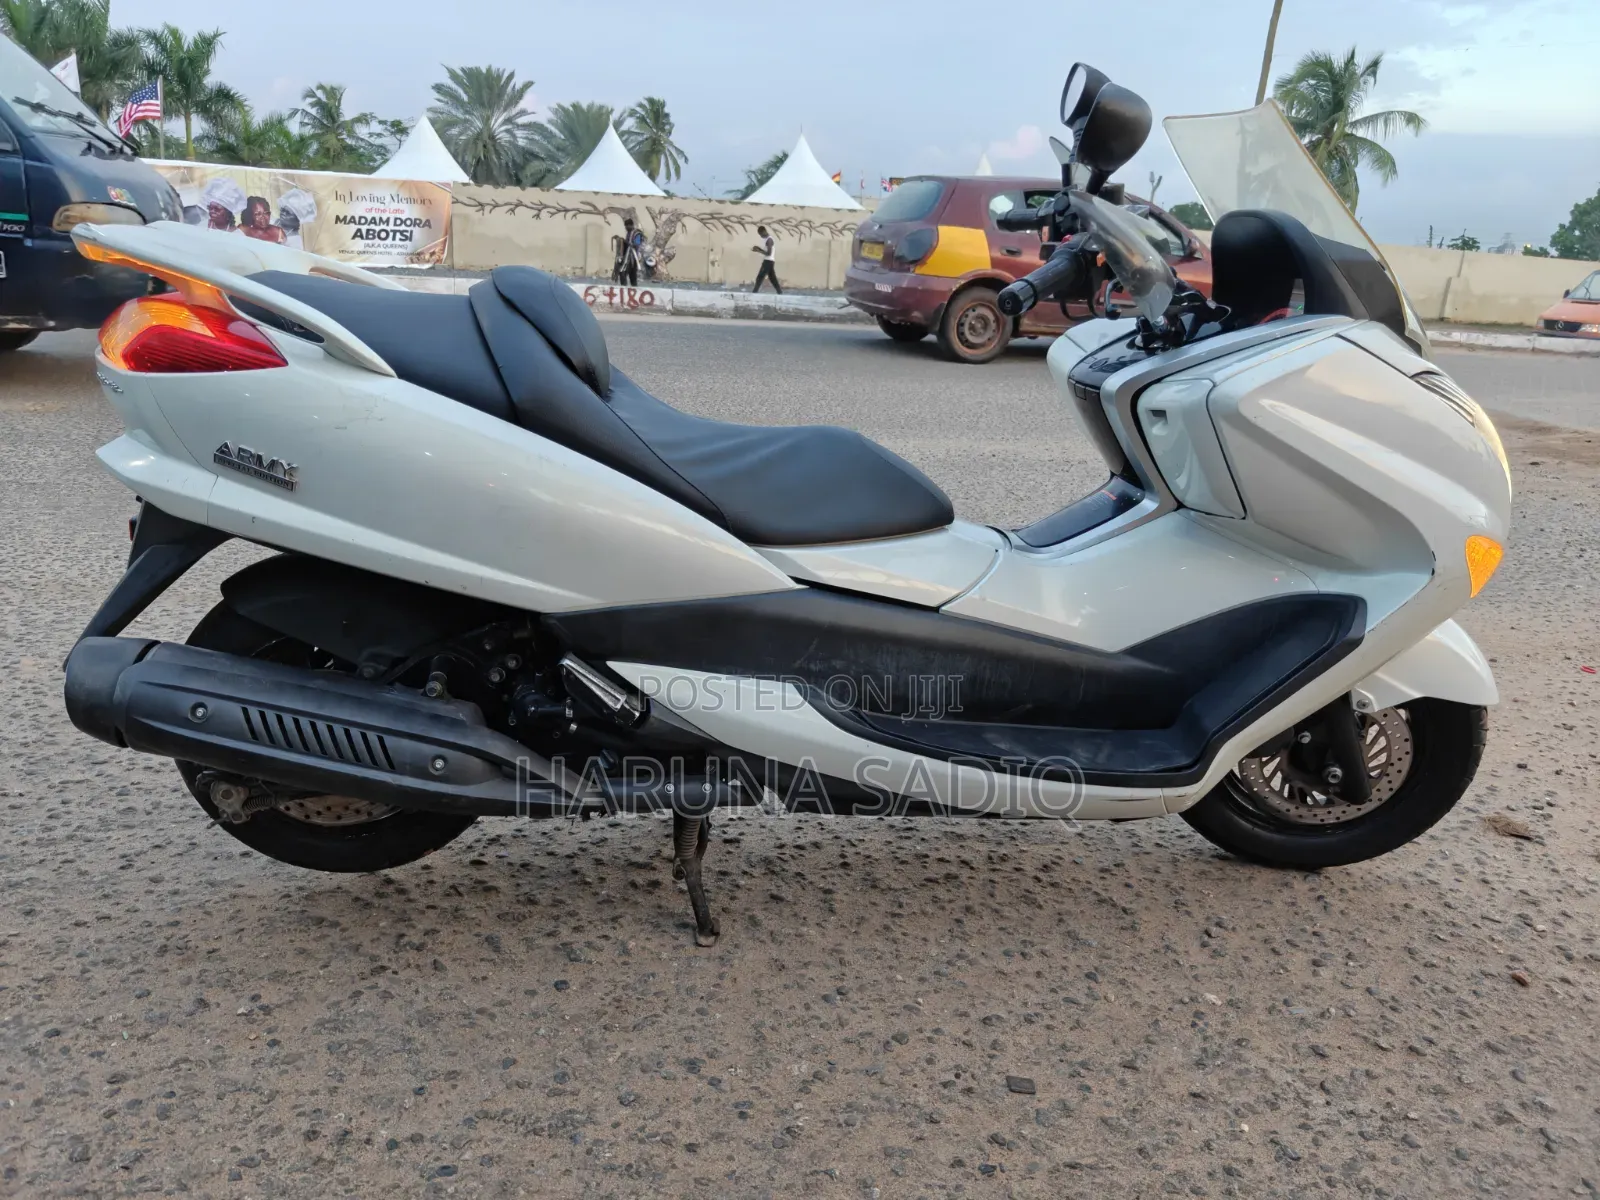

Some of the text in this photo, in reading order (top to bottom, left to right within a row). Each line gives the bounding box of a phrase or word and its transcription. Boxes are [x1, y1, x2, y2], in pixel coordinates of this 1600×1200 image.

[335, 189, 433, 206] In Loving Memory
[334, 214, 433, 230] MADAM DORA
[350, 228, 414, 243] ABOTSI
[215, 440, 299, 480] ARMY
